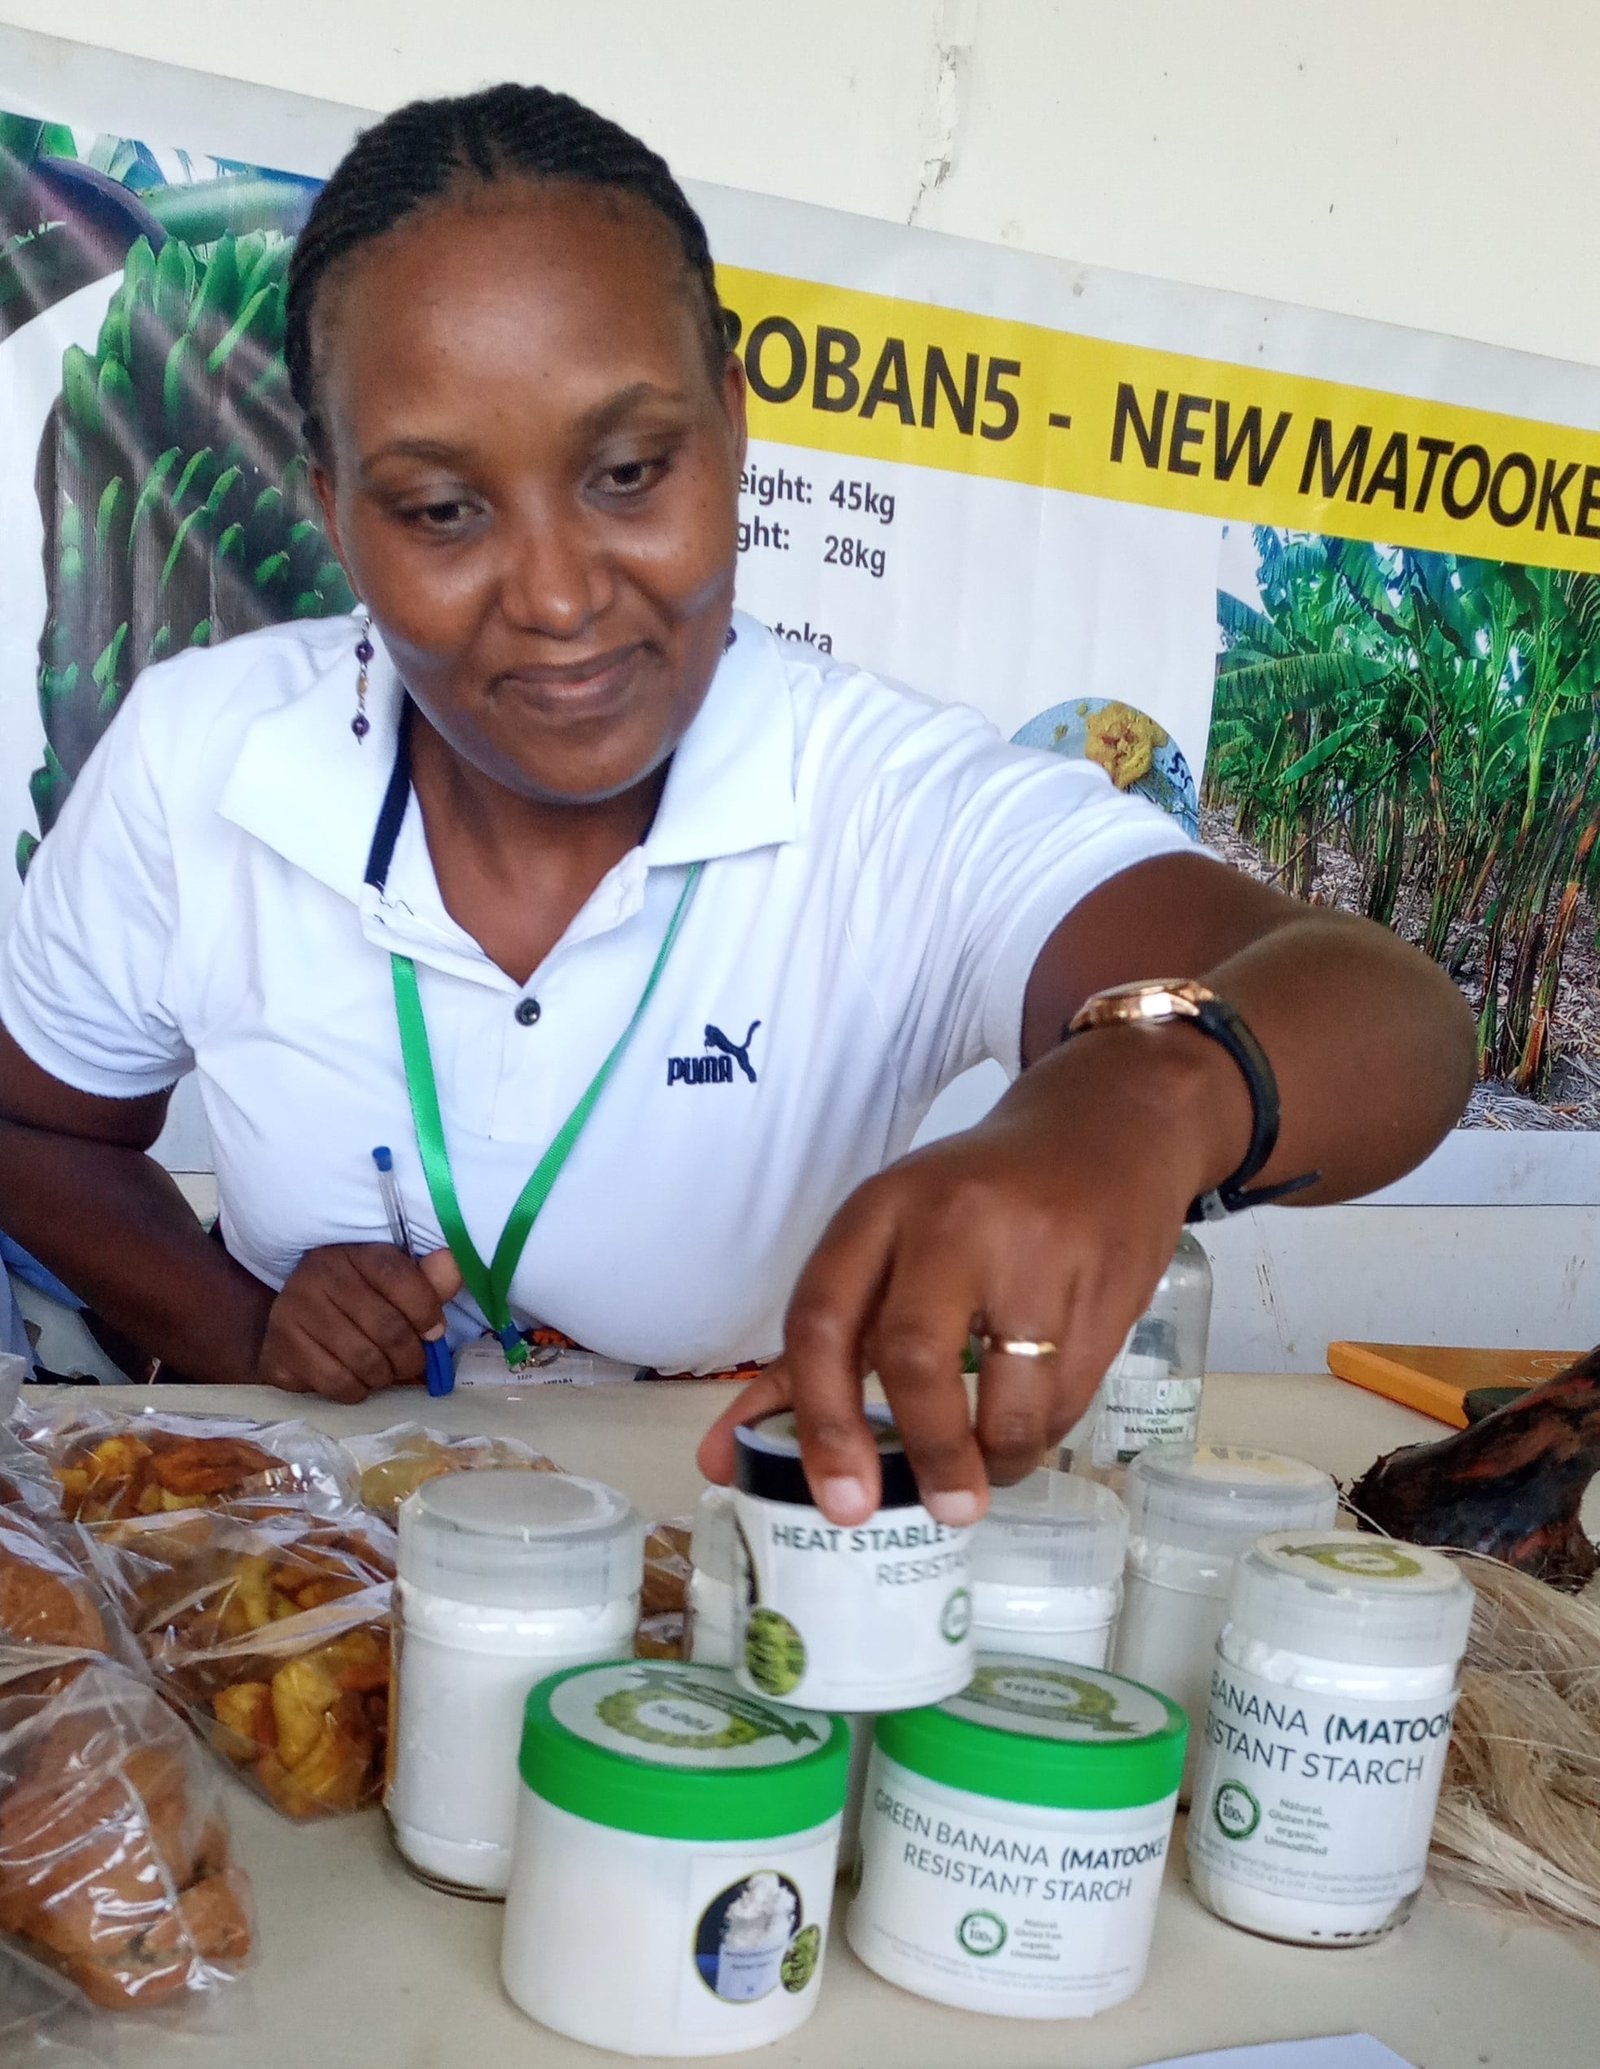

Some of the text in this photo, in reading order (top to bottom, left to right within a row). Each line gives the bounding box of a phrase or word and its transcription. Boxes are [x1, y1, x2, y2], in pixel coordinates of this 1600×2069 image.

[1048, 412, 1071, 431] -
[1109, 381, 1293, 488] NEW
[1297, 416, 1600, 540] MATOOKE
[739, 464, 896, 524] eight: 45kg
[737, 515, 886, 578] ght: 28kg
[773, 622, 833, 656] toka
[667, 1055, 733, 1086] PUMA
[771, 1523, 841, 1551] HEAT
[850, 1522, 944, 1552] STABLE
[1301, 1753, 1424, 1785] STARCH
[873, 1787, 932, 1838] GREEN
[936, 1821, 1050, 1868] BANANA
[1268, 1808, 1304, 1825] Gluten
[904, 1841, 1132, 1902] RESISTANT STARCH
